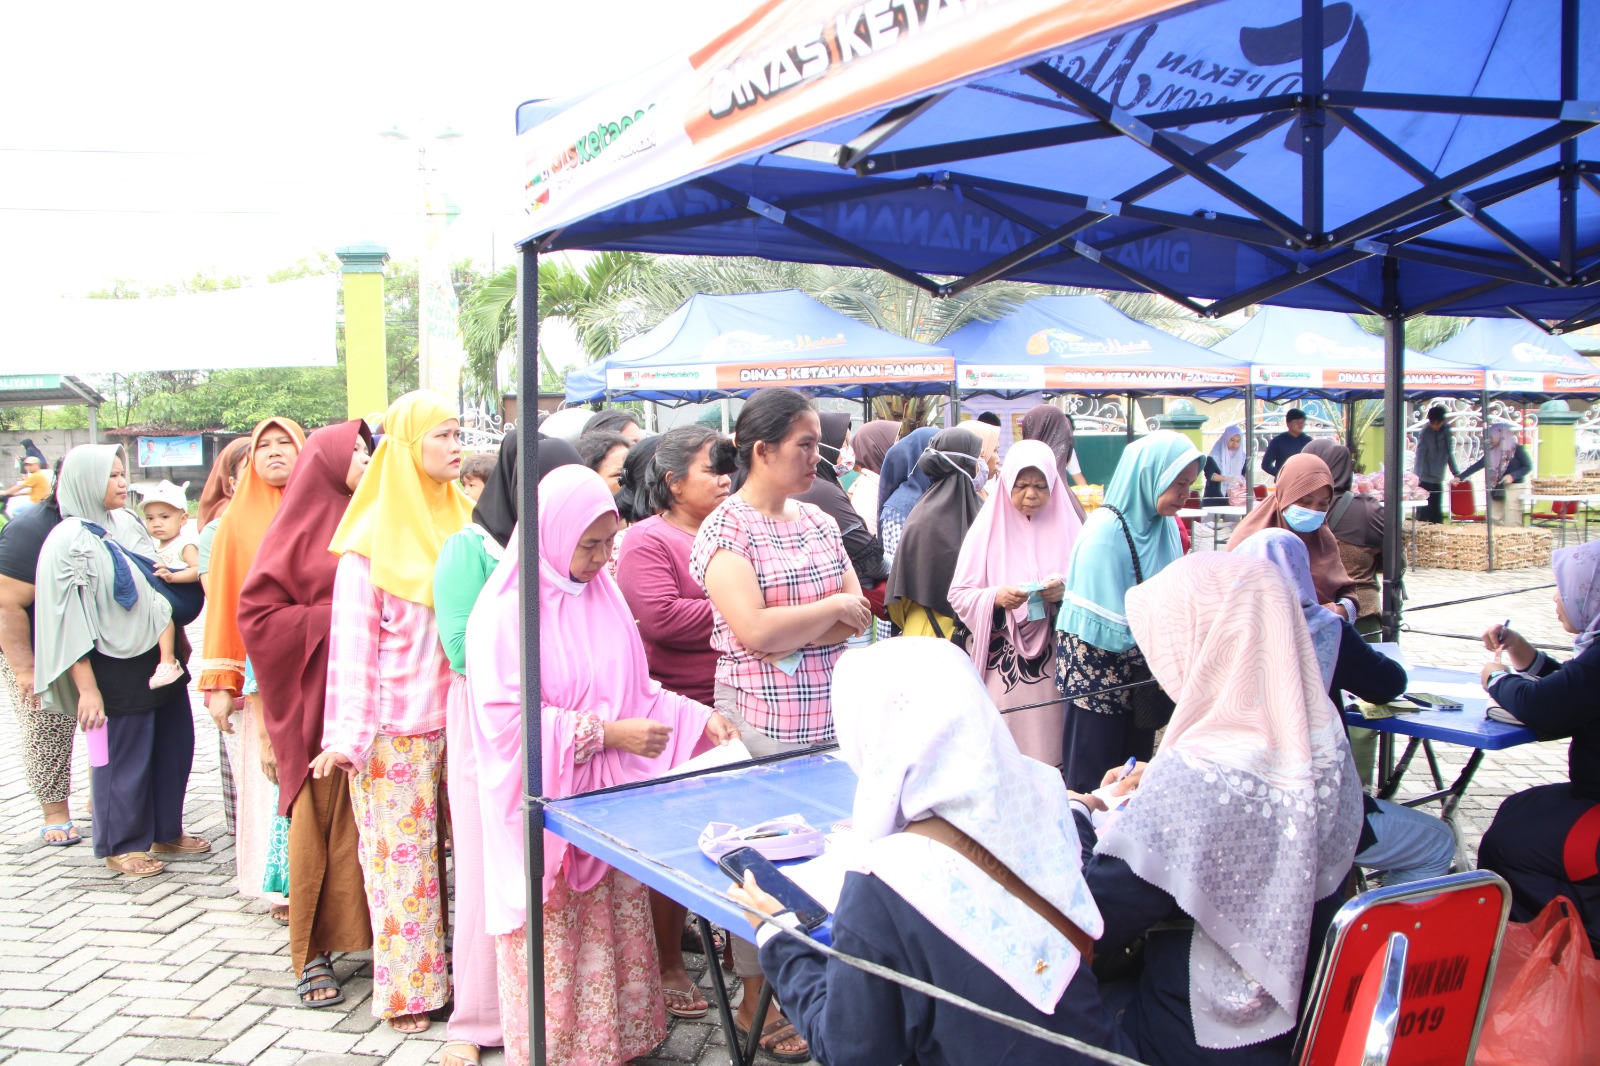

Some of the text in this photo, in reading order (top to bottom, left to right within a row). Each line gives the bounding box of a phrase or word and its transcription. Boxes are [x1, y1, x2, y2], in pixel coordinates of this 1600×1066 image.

[709, 24, 830, 118] DINAS
[740, 363, 944, 382] DINAS KETAHANAN PANGAN
[1065, 371, 1104, 382] DINAS
[1107, 371, 1183, 382] KETAHANAN
[1338, 372, 1475, 385] DINAS KEANAN PANGAN
[36, 377, 44, 388] II
[1433, 954, 1470, 995] RAYA
[1396, 1005, 1445, 1038] 019
